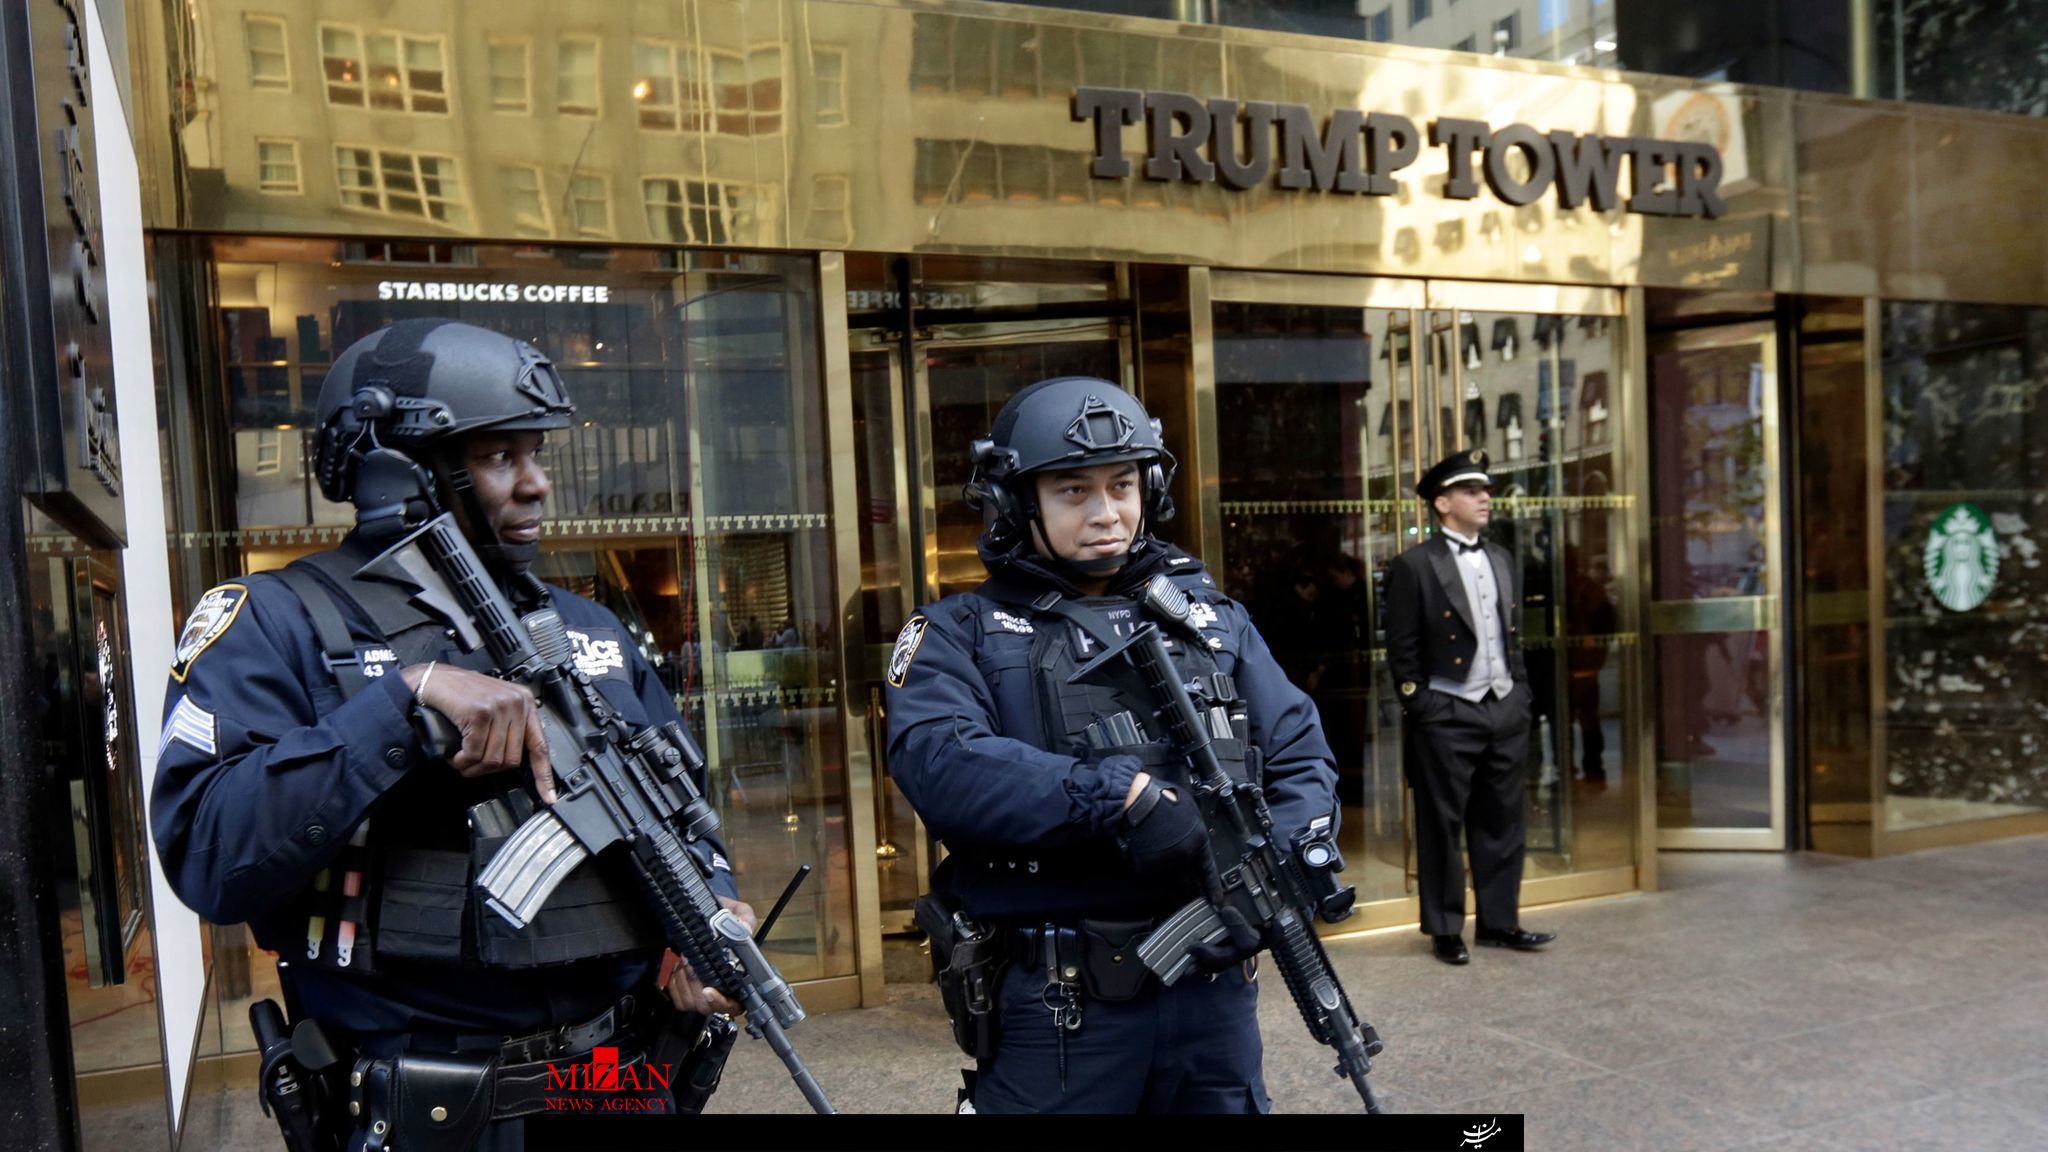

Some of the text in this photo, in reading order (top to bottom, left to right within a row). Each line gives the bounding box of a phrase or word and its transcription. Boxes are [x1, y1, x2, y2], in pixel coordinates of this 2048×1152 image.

[1072, 86, 1728, 219] TRUMP TOWER
[377, 280, 609, 305] STARBUCKS COFFEE
[1107, 608, 1132, 621] NYPD
[363, 663, 385, 678] 43
